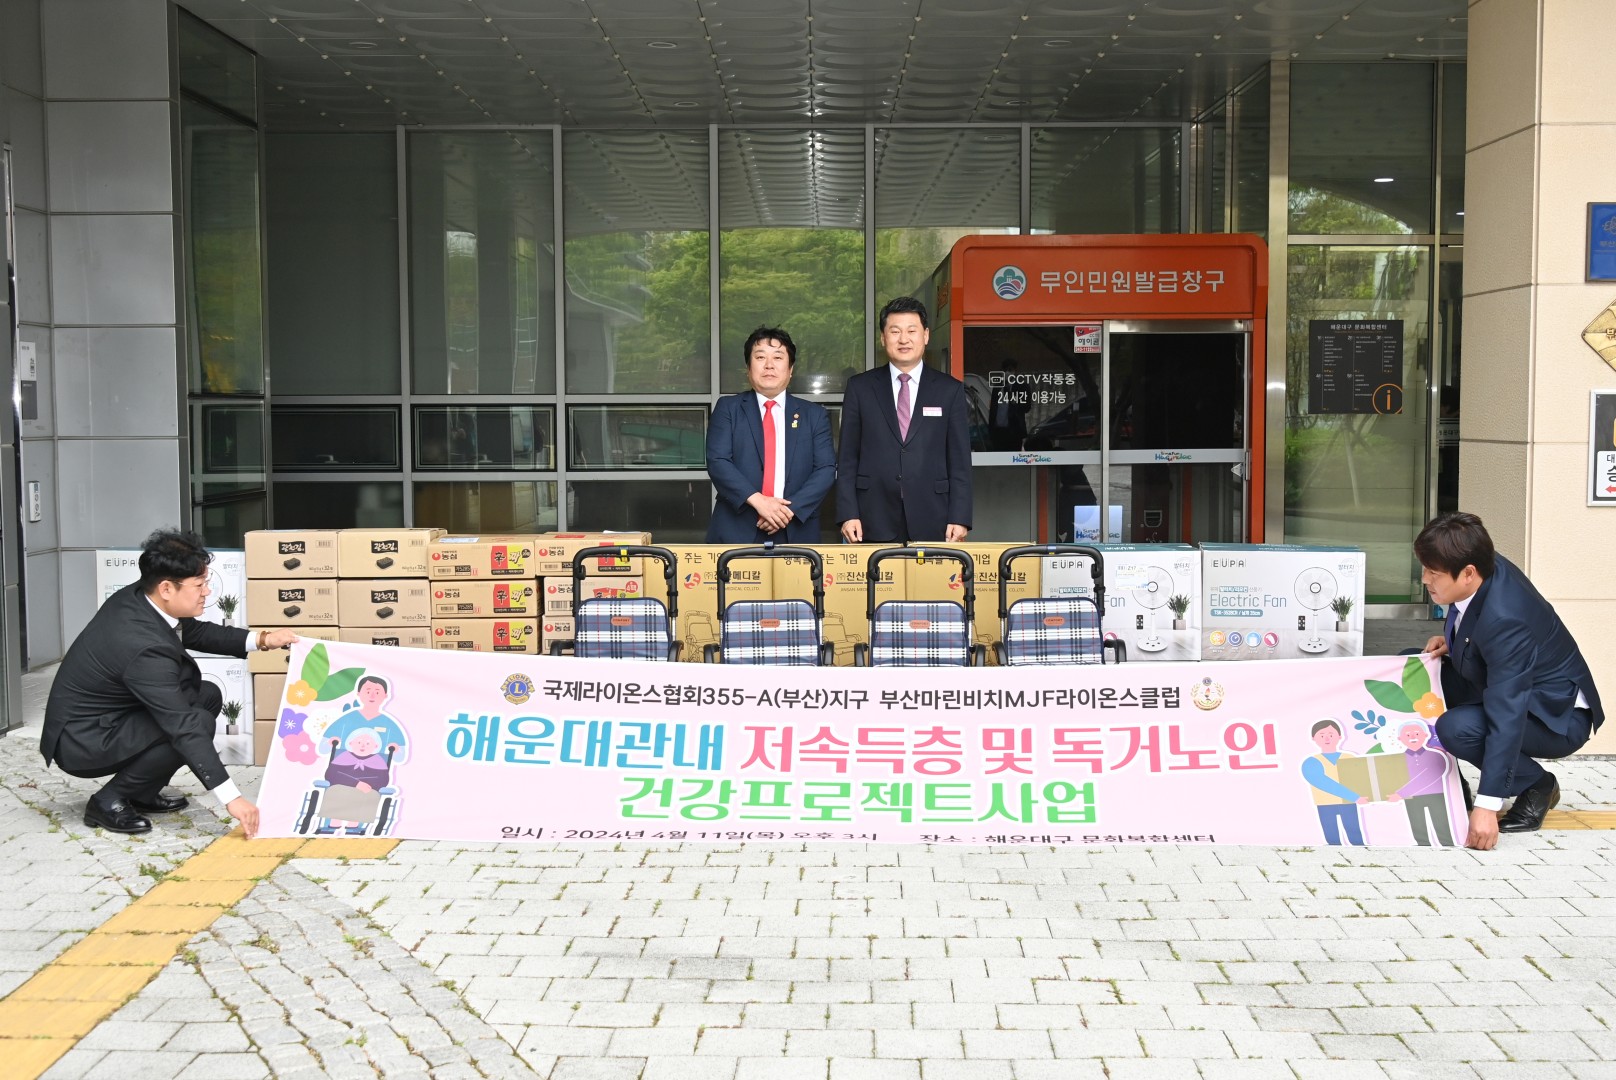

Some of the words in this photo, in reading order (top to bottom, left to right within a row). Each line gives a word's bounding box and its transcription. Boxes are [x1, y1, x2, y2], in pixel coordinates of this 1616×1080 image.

[1041, 270, 1225, 294] 무인민원발급창구
[1007, 373, 1077, 386] CCTV작동중
[997, 391, 1028, 404] 24시간
[1031, 390, 1067, 404] 이용가능
[684, 552, 702, 564] 주는
[840, 553, 858, 565] 기업
[972, 553, 991, 565] 기업
[1210, 594, 1260, 607] Electric
[1264, 594, 1287, 607] Fan
[555, 624, 571, 632] 농심
[543, 679, 870, 710] 국제라이온스협회355-A(부산)지구
[879, 686, 1180, 710] 부산마린비치MJF라이온스클럽
[446, 713, 724, 771] 해운대관내
[741, 725, 963, 776] 저속득층
[981, 728, 1033, 775] 및
[1052, 722, 1279, 774] 독거노인
[620, 777, 1097, 824] 건강프로젝트사업
[501, 826, 544, 840] 일시
[563, 829, 645, 840] 2024년
[651, 830, 688, 840] 4월
[697, 831, 785, 840] 11일(목)
[984, 834, 1074, 844] 해운대구
